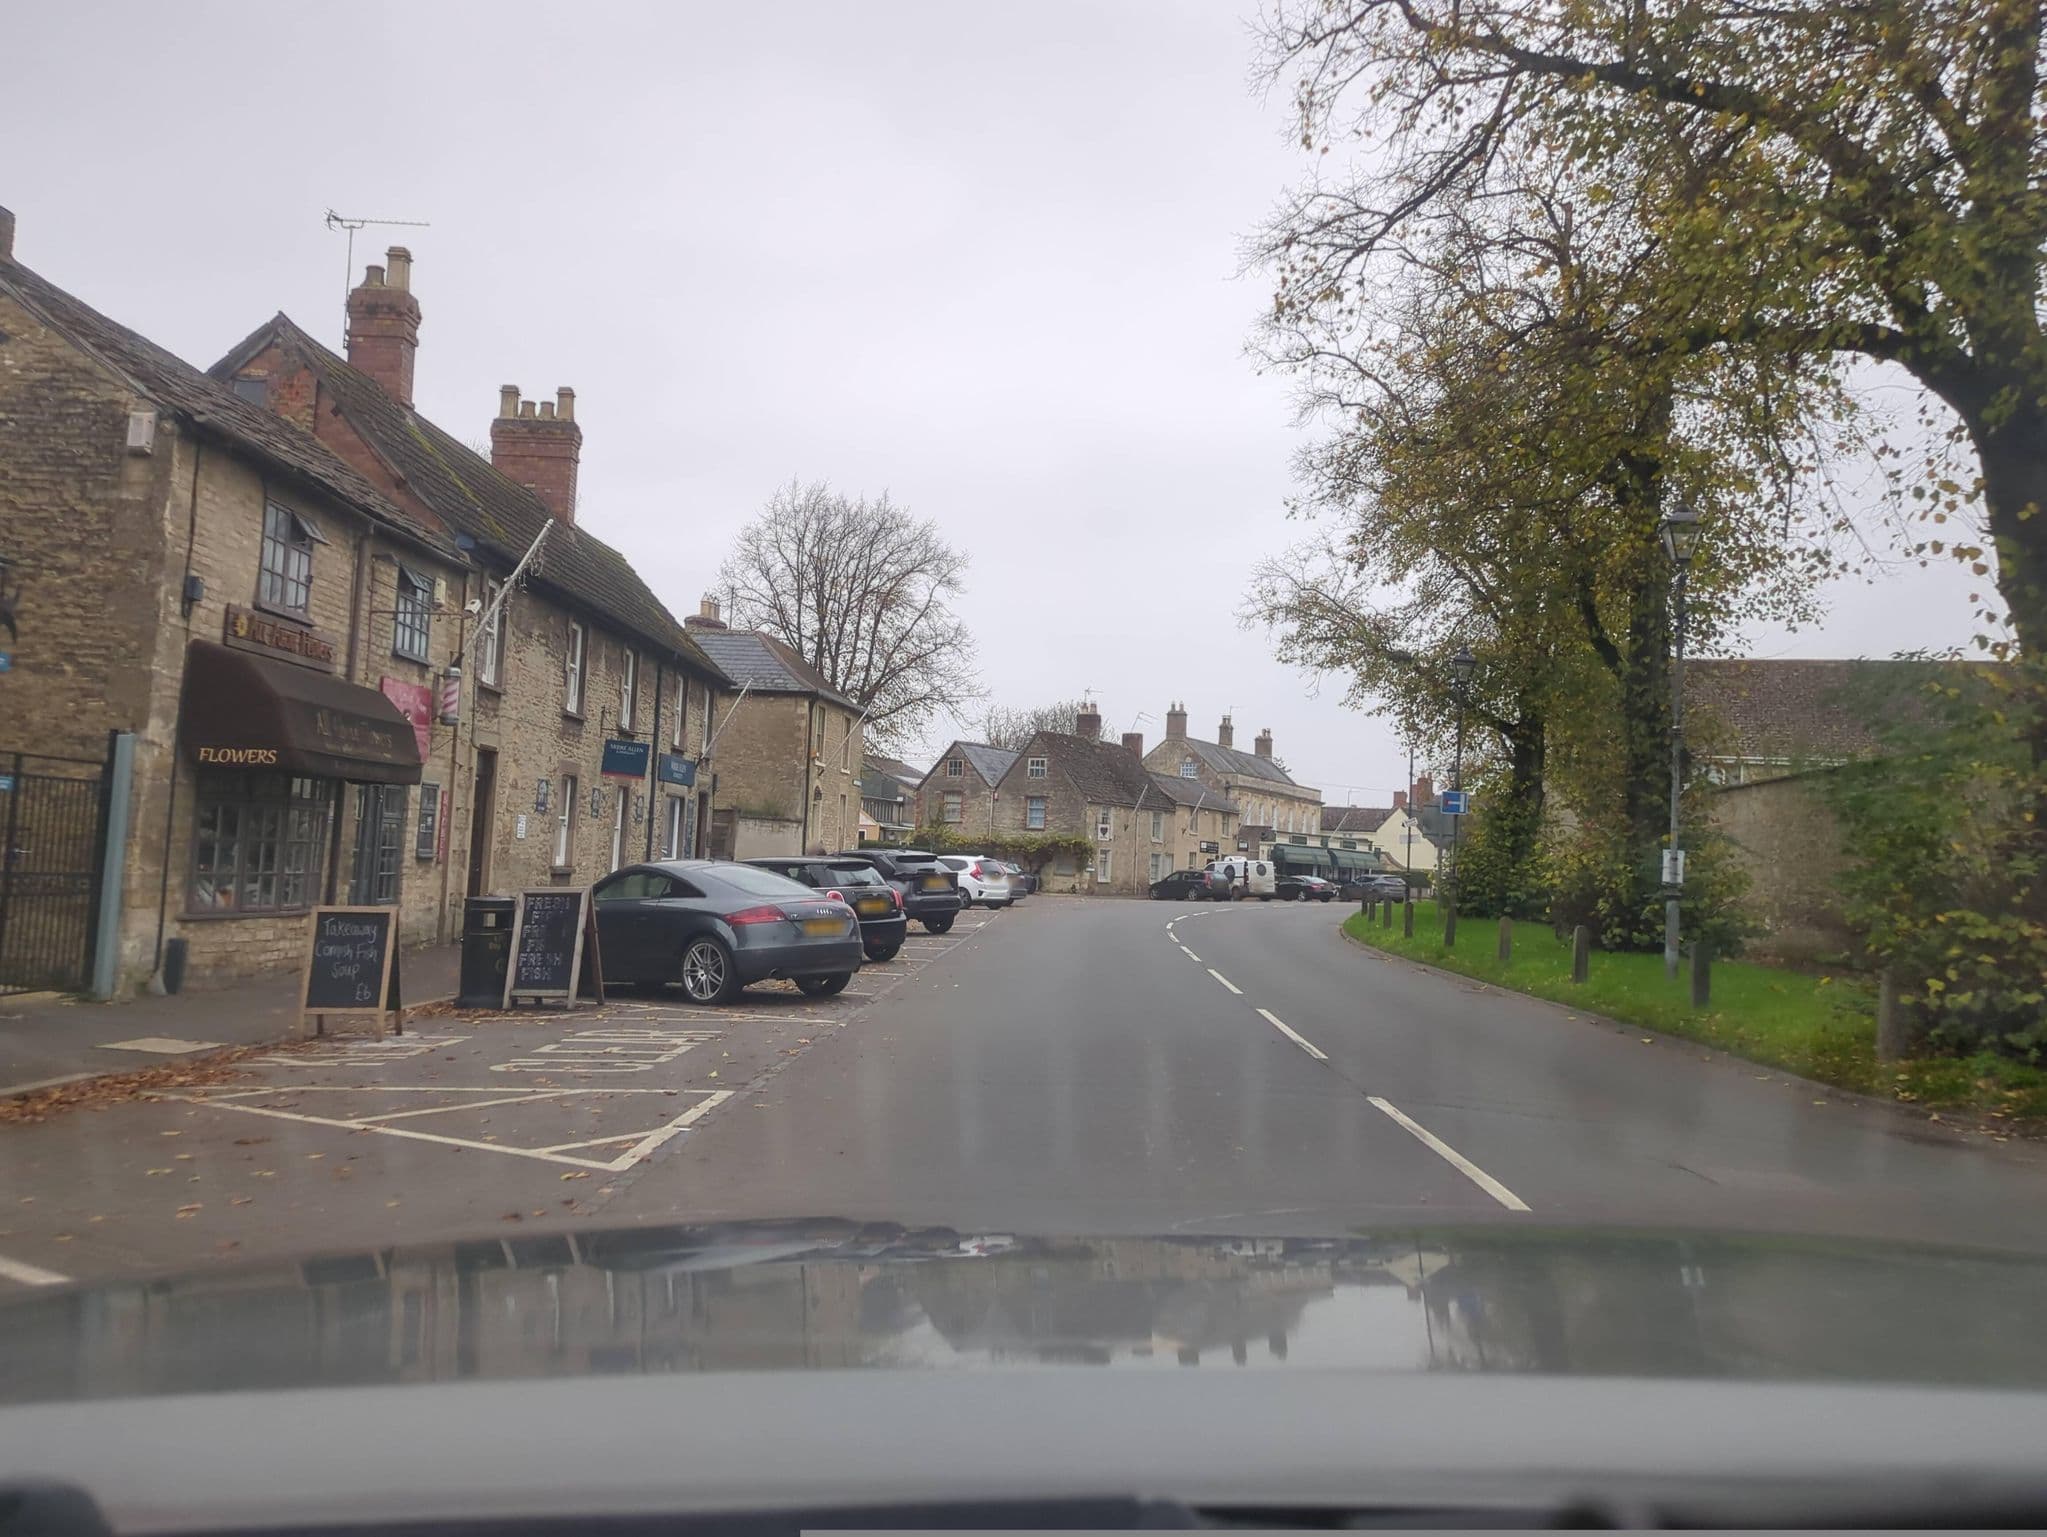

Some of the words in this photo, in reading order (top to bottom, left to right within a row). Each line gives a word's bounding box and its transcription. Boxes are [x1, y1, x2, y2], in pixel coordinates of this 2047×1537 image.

[200, 747, 278, 764] FLOWERS
[323, 917, 377, 944] Takeaway
[331, 962, 360, 980] Soup
[489, 1029, 722, 1072] CLEAR
